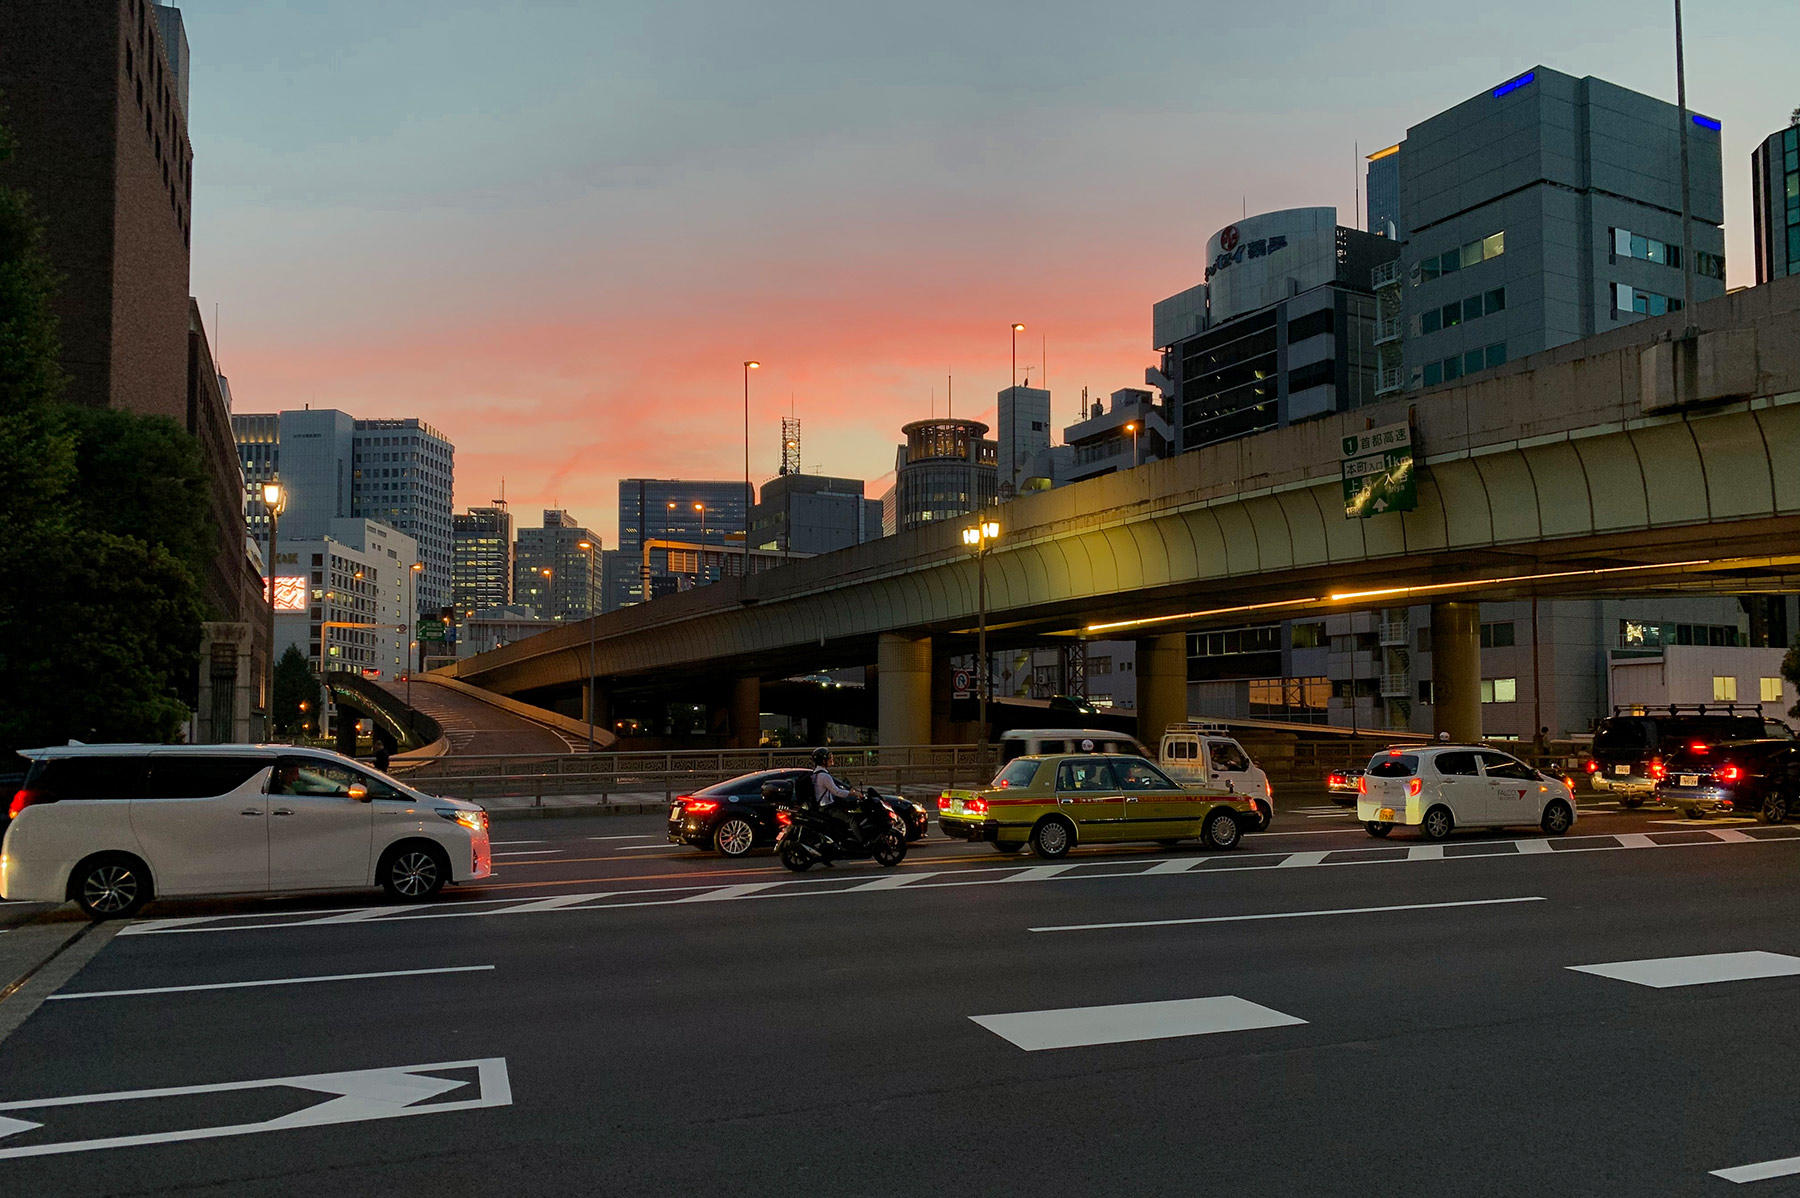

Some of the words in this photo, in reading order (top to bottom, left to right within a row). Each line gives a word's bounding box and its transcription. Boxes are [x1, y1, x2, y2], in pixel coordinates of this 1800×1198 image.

[1347, 440, 1353, 451] 1
[1361, 428, 1407, 449] 首都高速
[1346, 461, 1383, 475] 本町入口
